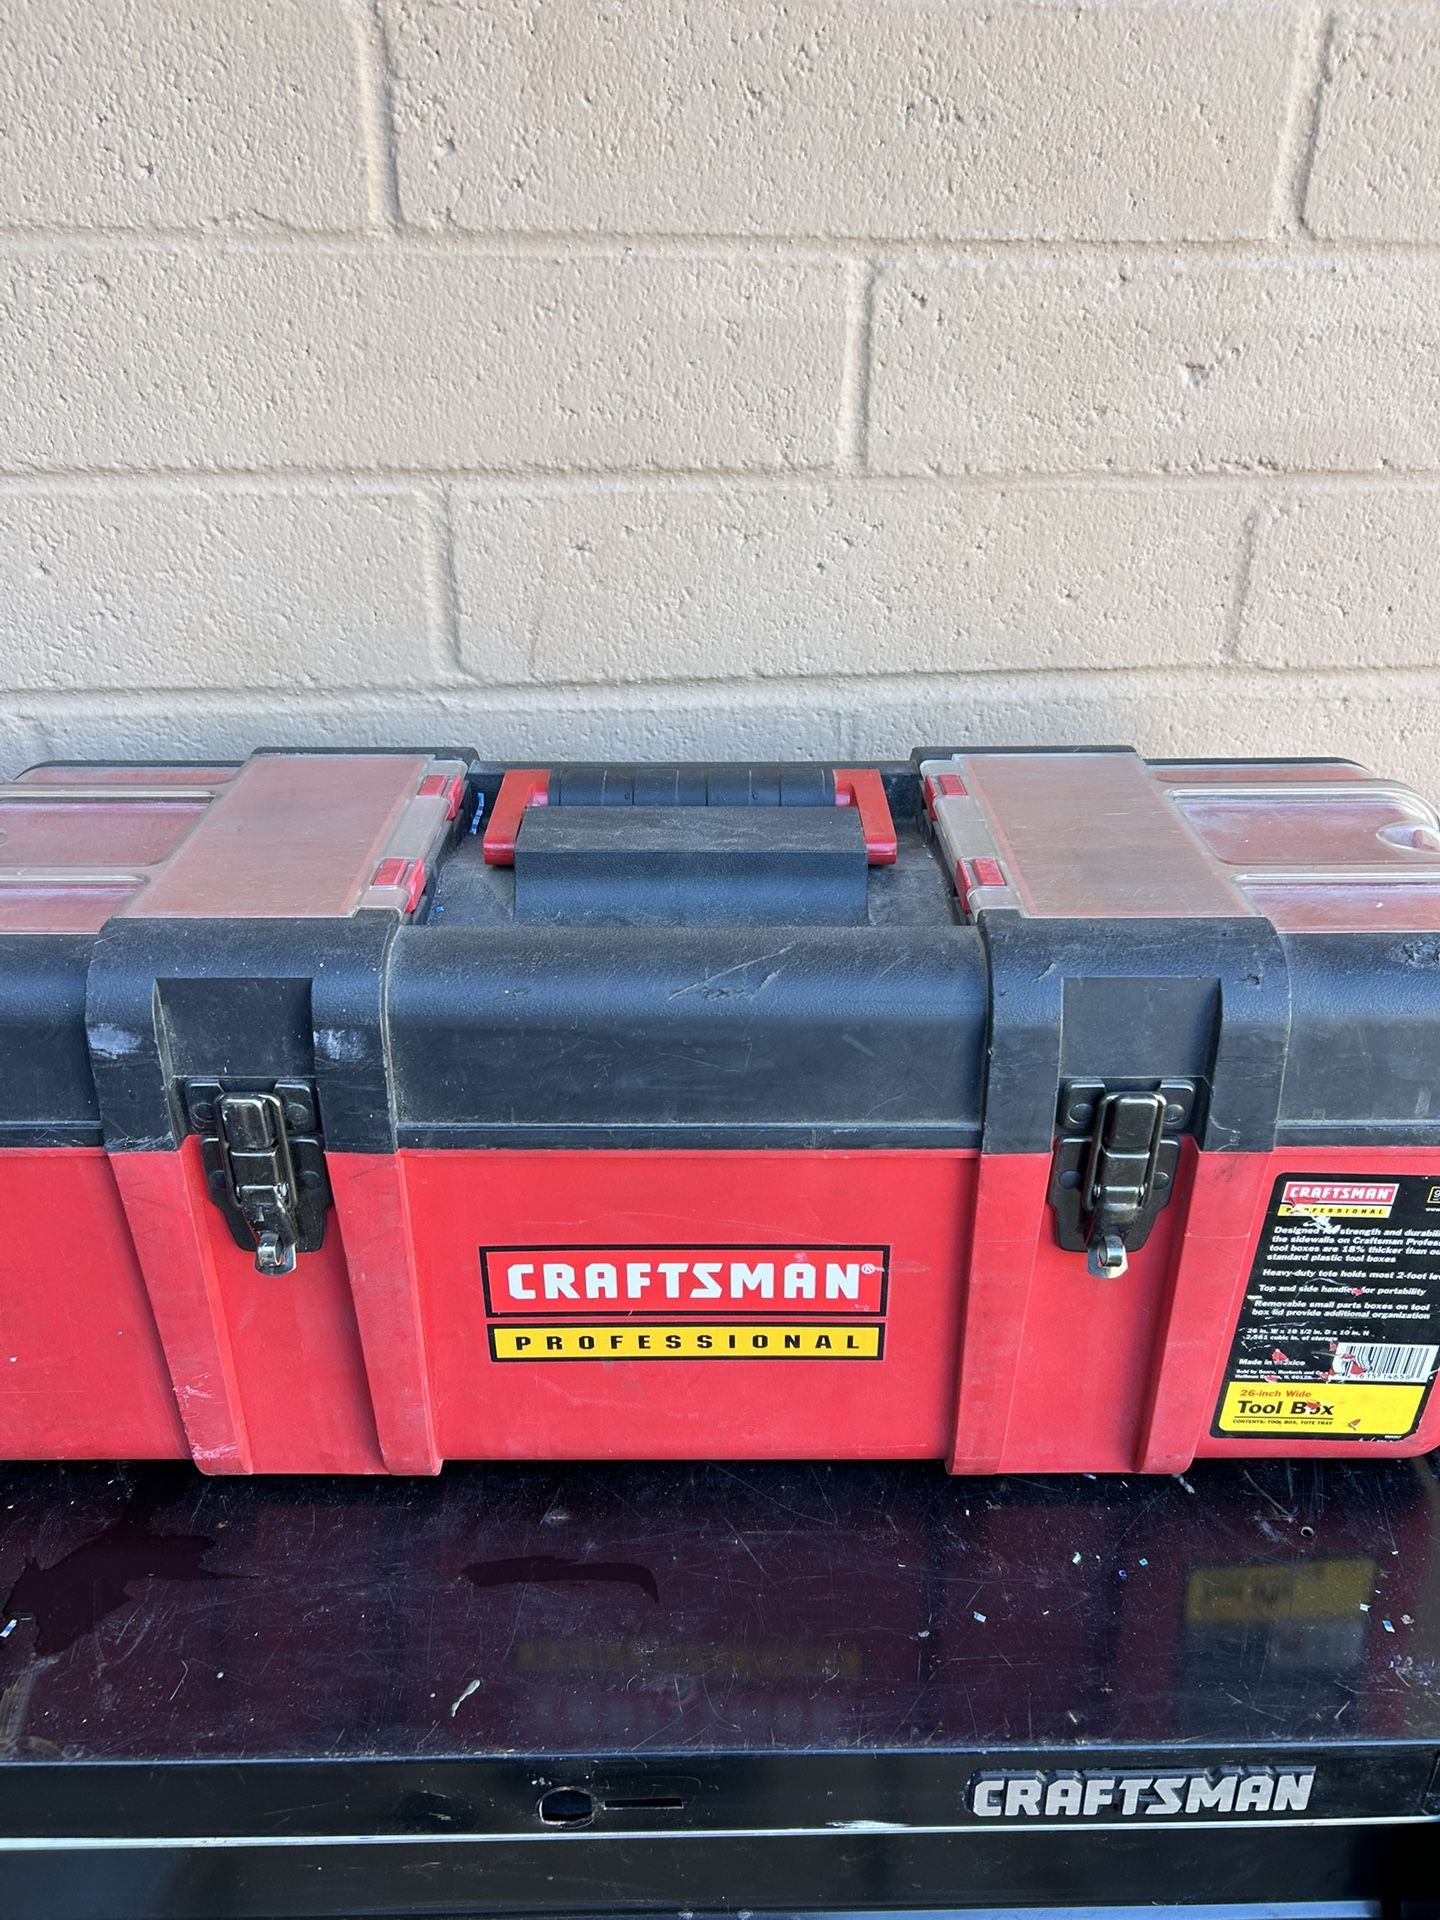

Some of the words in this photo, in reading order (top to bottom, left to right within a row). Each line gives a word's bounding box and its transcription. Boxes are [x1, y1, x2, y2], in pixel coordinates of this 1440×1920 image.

[1290, 1186, 1393, 1200] CRAFTSMAN
[1285, 1207, 1383, 1215] PFESSIONAL
[1274, 1226, 1319, 1235] Designed
[1340, 1227, 1381, 1237] strength
[1272, 1235, 1288, 1243] the
[1352, 1237, 1404, 1245] Craftsman
[1269, 1244, 1289, 1252] tool
[1290, 1244, 1320, 1252] boxes
[1341, 1245, 1366, 1253] 18%
[1368, 1246, 1403, 1254] thicker
[1405, 1247, 1427, 1255] than
[1266, 1253, 1309, 1261] standard
[1310, 1254, 1343, 1263] plastic
[1366, 1255, 1397, 1263] boxes
[1262, 1269, 1317, 1278] Heavy-duty
[1340, 1270, 1367, 1278] holds
[1396, 1272, 1428, 1280] 2-foot
[1259, 1284, 1277, 1292] Top
[1321, 1286, 1359, 1294] handle
[1361, 1286, 1376, 1294] for
[1377, 1287, 1427, 1296] portability
[1254, 1300, 1307, 1308] Removable
[1336, 1302, 1362, 1310] parts
[1364, 1302, 1393, 1310] boxes
[1252, 1308, 1270, 1316] box
[1272, 1308, 1284, 1316] lid
[1286, 1309, 1321, 1317] provide
[1323, 1310, 1370, 1318] additional
[515, 1334, 860, 1351] PROFESSIONAL
[1240, 1389, 1281, 1398] 26-inch
[1238, 1400, 1283, 1414] Tool
[971, 1770, 1315, 1817] CRAFTSMAN
